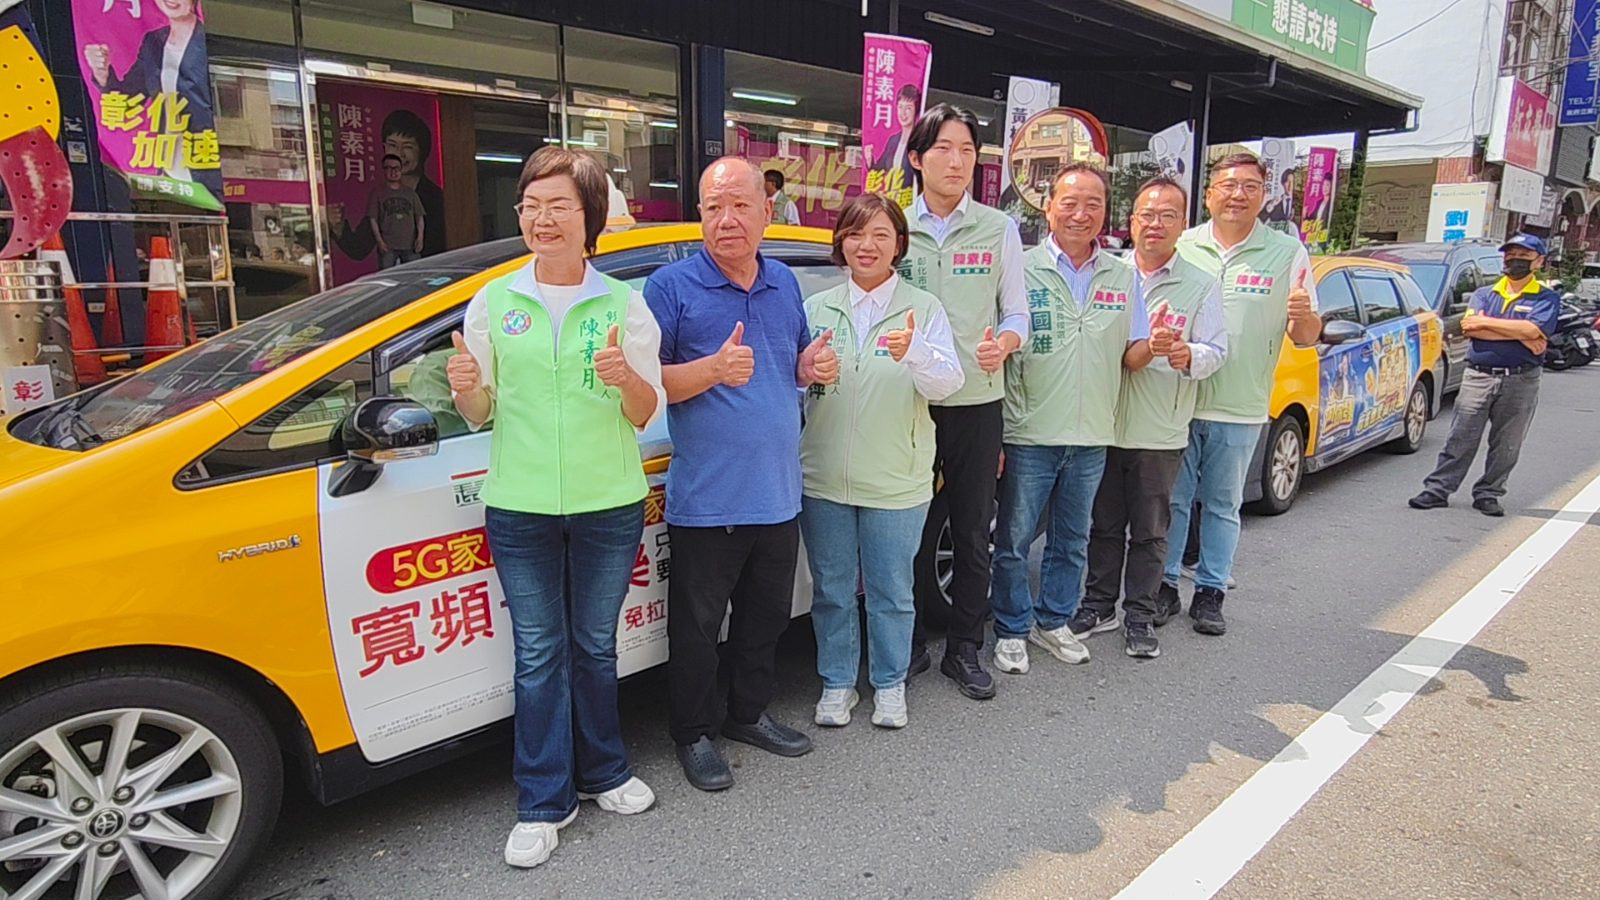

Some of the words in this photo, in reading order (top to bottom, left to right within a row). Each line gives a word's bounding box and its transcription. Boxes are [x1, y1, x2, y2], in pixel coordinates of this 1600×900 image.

[1272, 0, 1338, 54] 懇請支持
[101, 91, 191, 132] 彰化
[873, 48, 896, 129] 陳素月
[129, 129, 221, 170] 加速
[338, 103, 365, 182] 陳素月
[865, 167, 905, 193] 彰化
[1028, 288, 1053, 355] 葉國雄
[13, 381, 44, 401] 彰
[218, 539, 289, 563] HYBRID
[393, 534, 494, 587] 5G家
[351, 581, 508, 679] 寬頻
